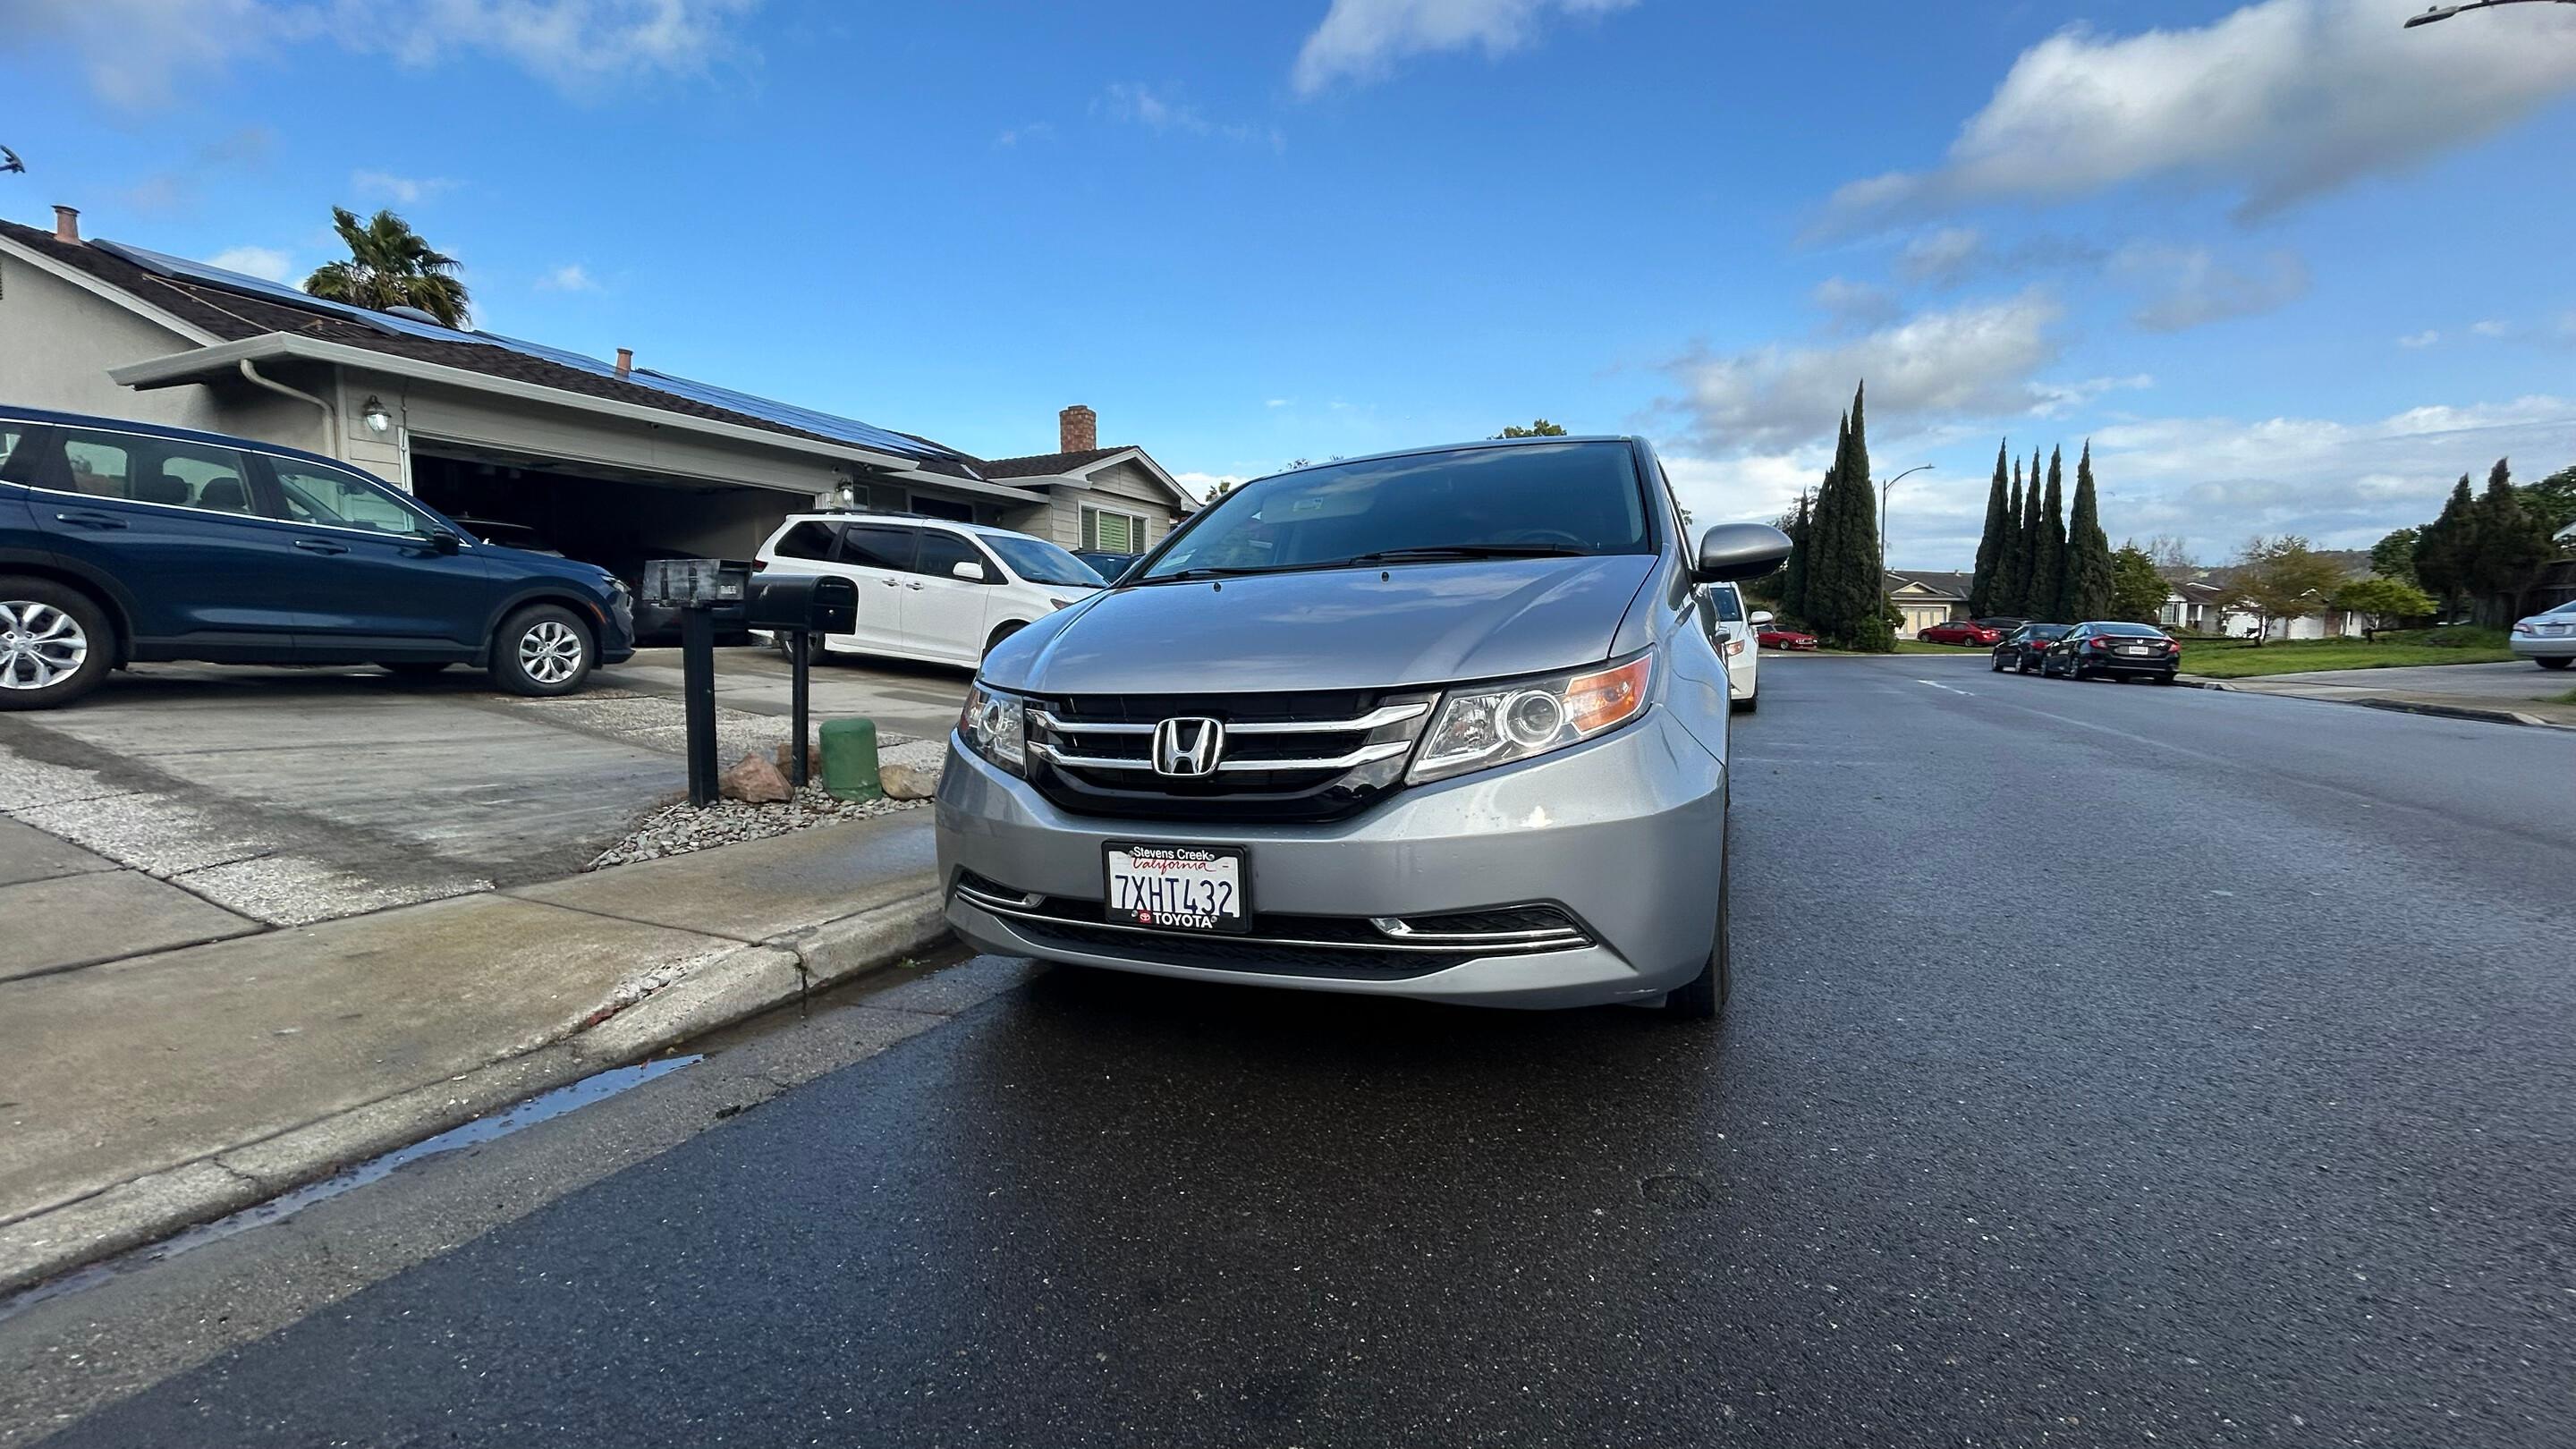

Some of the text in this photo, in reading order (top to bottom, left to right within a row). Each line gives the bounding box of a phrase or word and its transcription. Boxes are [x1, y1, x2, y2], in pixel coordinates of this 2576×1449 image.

[1133, 846, 1208, 860] Stevens Creek
[1132, 858, 1216, 875] California
[1114, 875, 1234, 916] 7XHT432
[1153, 912, 1213, 928] TOYOTA
